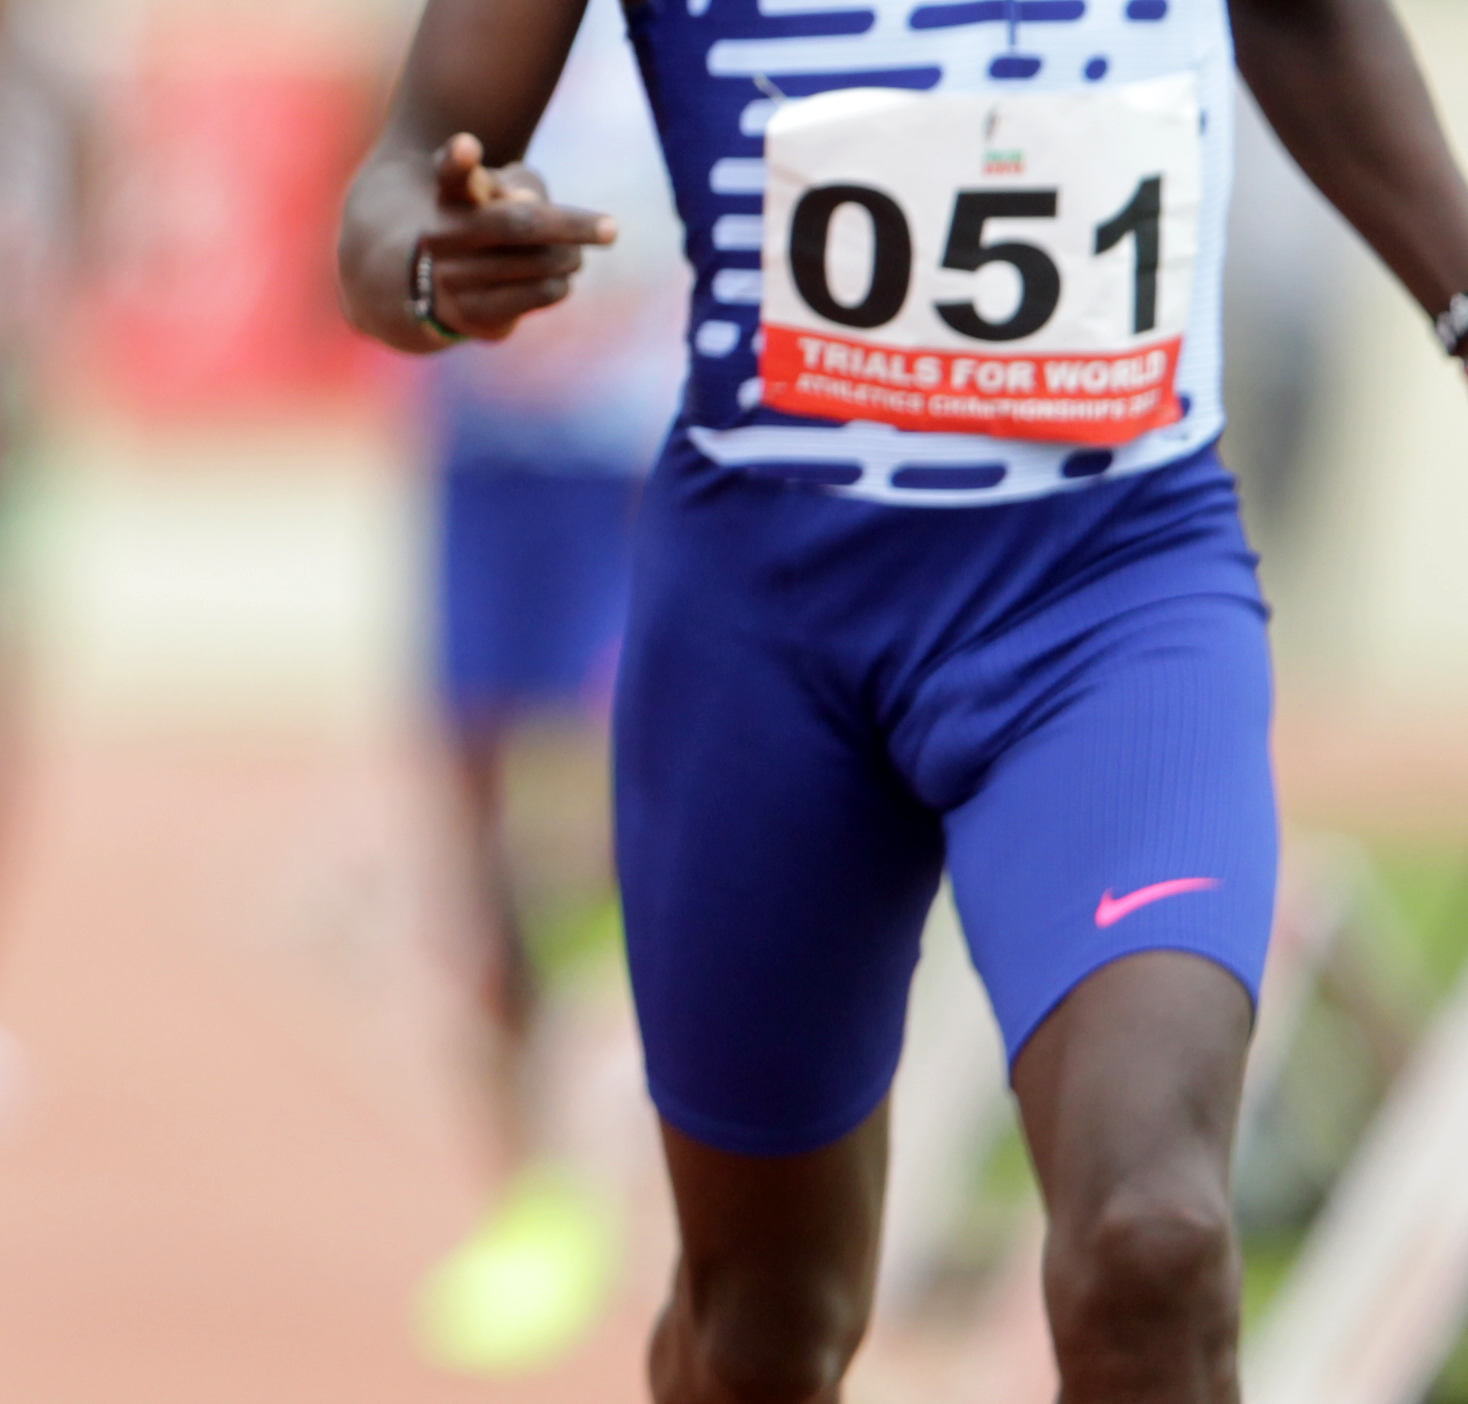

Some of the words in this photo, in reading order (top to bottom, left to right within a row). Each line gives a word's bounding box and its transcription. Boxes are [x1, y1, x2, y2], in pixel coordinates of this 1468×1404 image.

[789, 171, 1164, 342] 051
[797, 336, 943, 388] TRIALS
[950, 356, 1038, 394] FOR
[1044, 349, 1168, 396] WORLD
